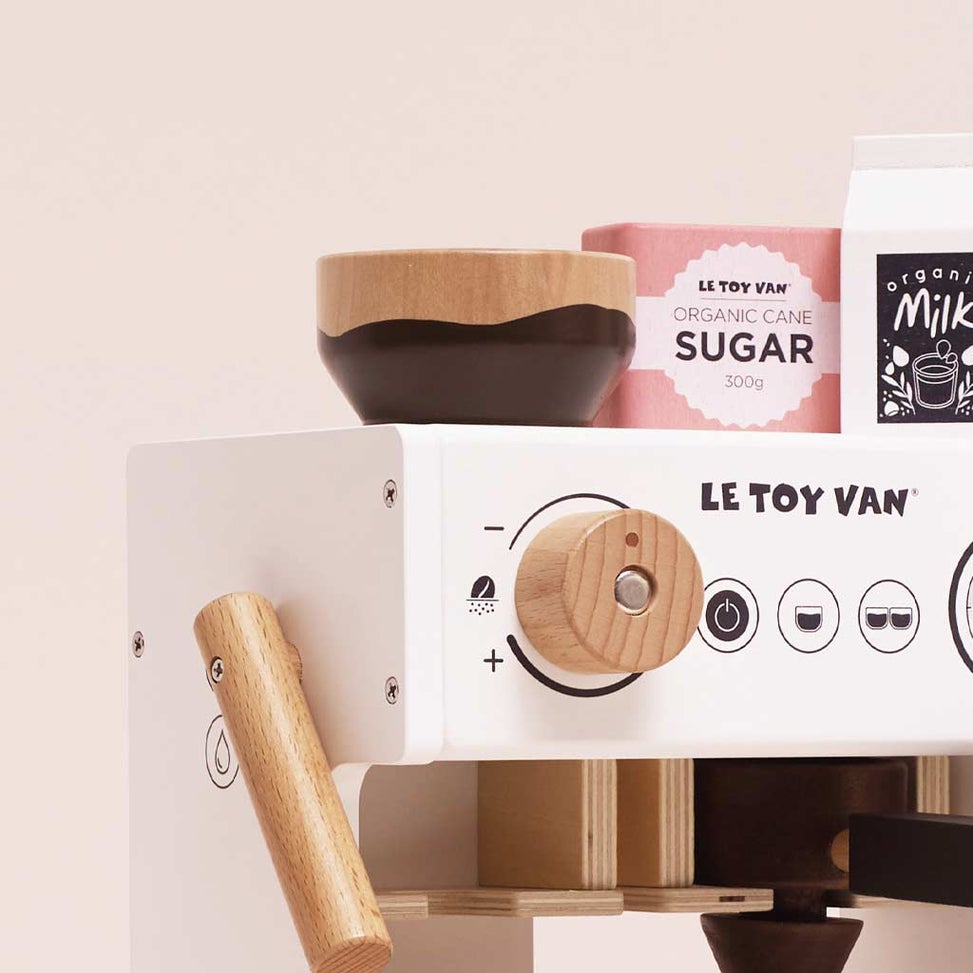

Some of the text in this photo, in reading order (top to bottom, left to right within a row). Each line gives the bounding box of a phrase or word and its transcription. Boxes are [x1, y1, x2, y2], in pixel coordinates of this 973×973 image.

[698, 280, 787, 295] LE TOY VAN
[673, 307, 813, 325] ORGANIC CANE
[675, 331, 814, 364] SUGAR
[725, 375, 764, 391] 300g
[701, 482, 909, 517] LE TOY VAN
